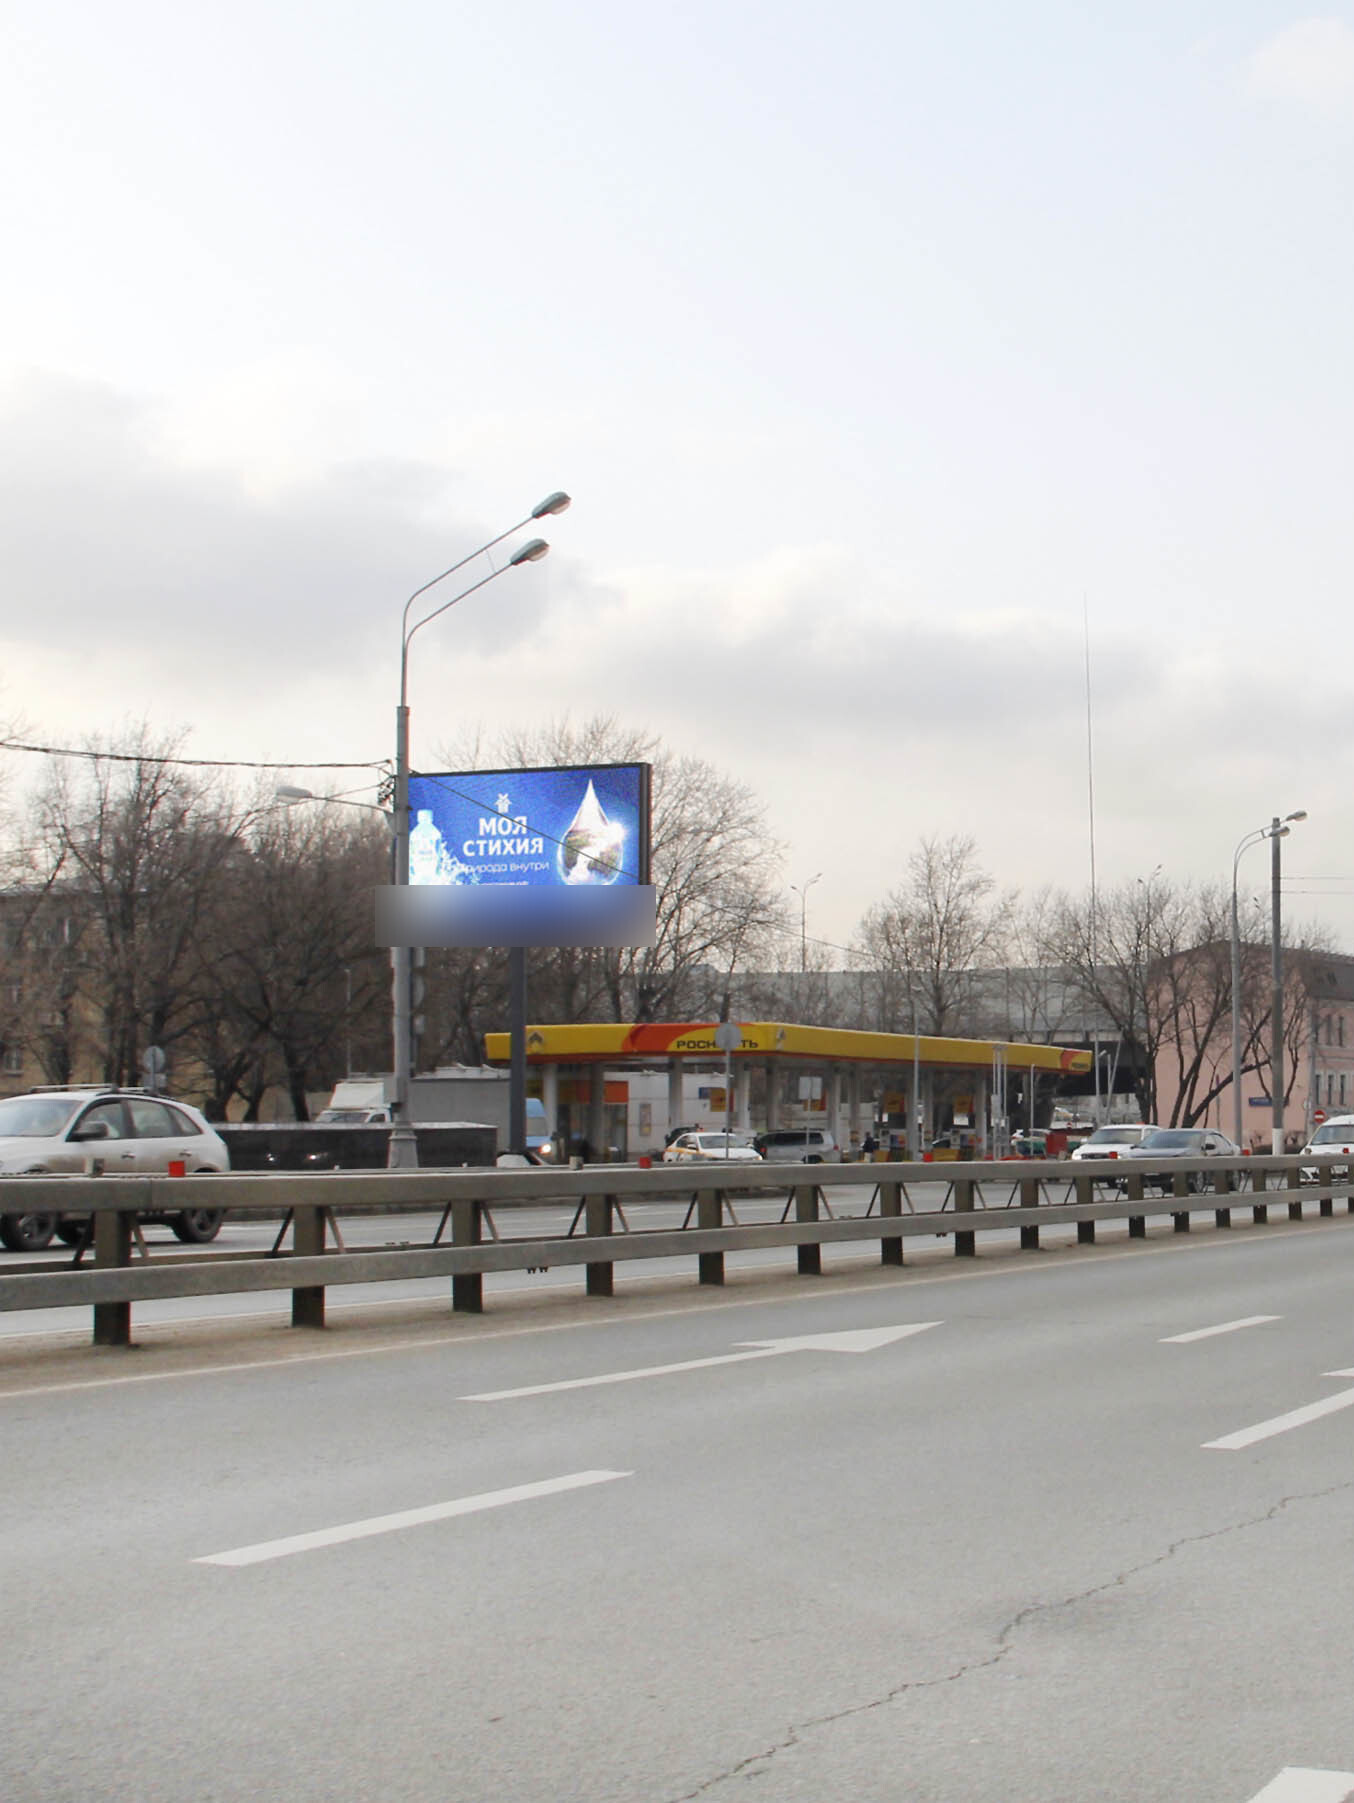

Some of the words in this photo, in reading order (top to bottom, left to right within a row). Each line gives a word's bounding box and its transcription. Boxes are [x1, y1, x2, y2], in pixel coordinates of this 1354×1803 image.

[478, 816, 528, 836] МОЯ
[463, 838, 544, 857] СТИХИЯ
[509, 862, 550, 873] внутри
[677, 1040, 759, 1049] РОСНТЬ
